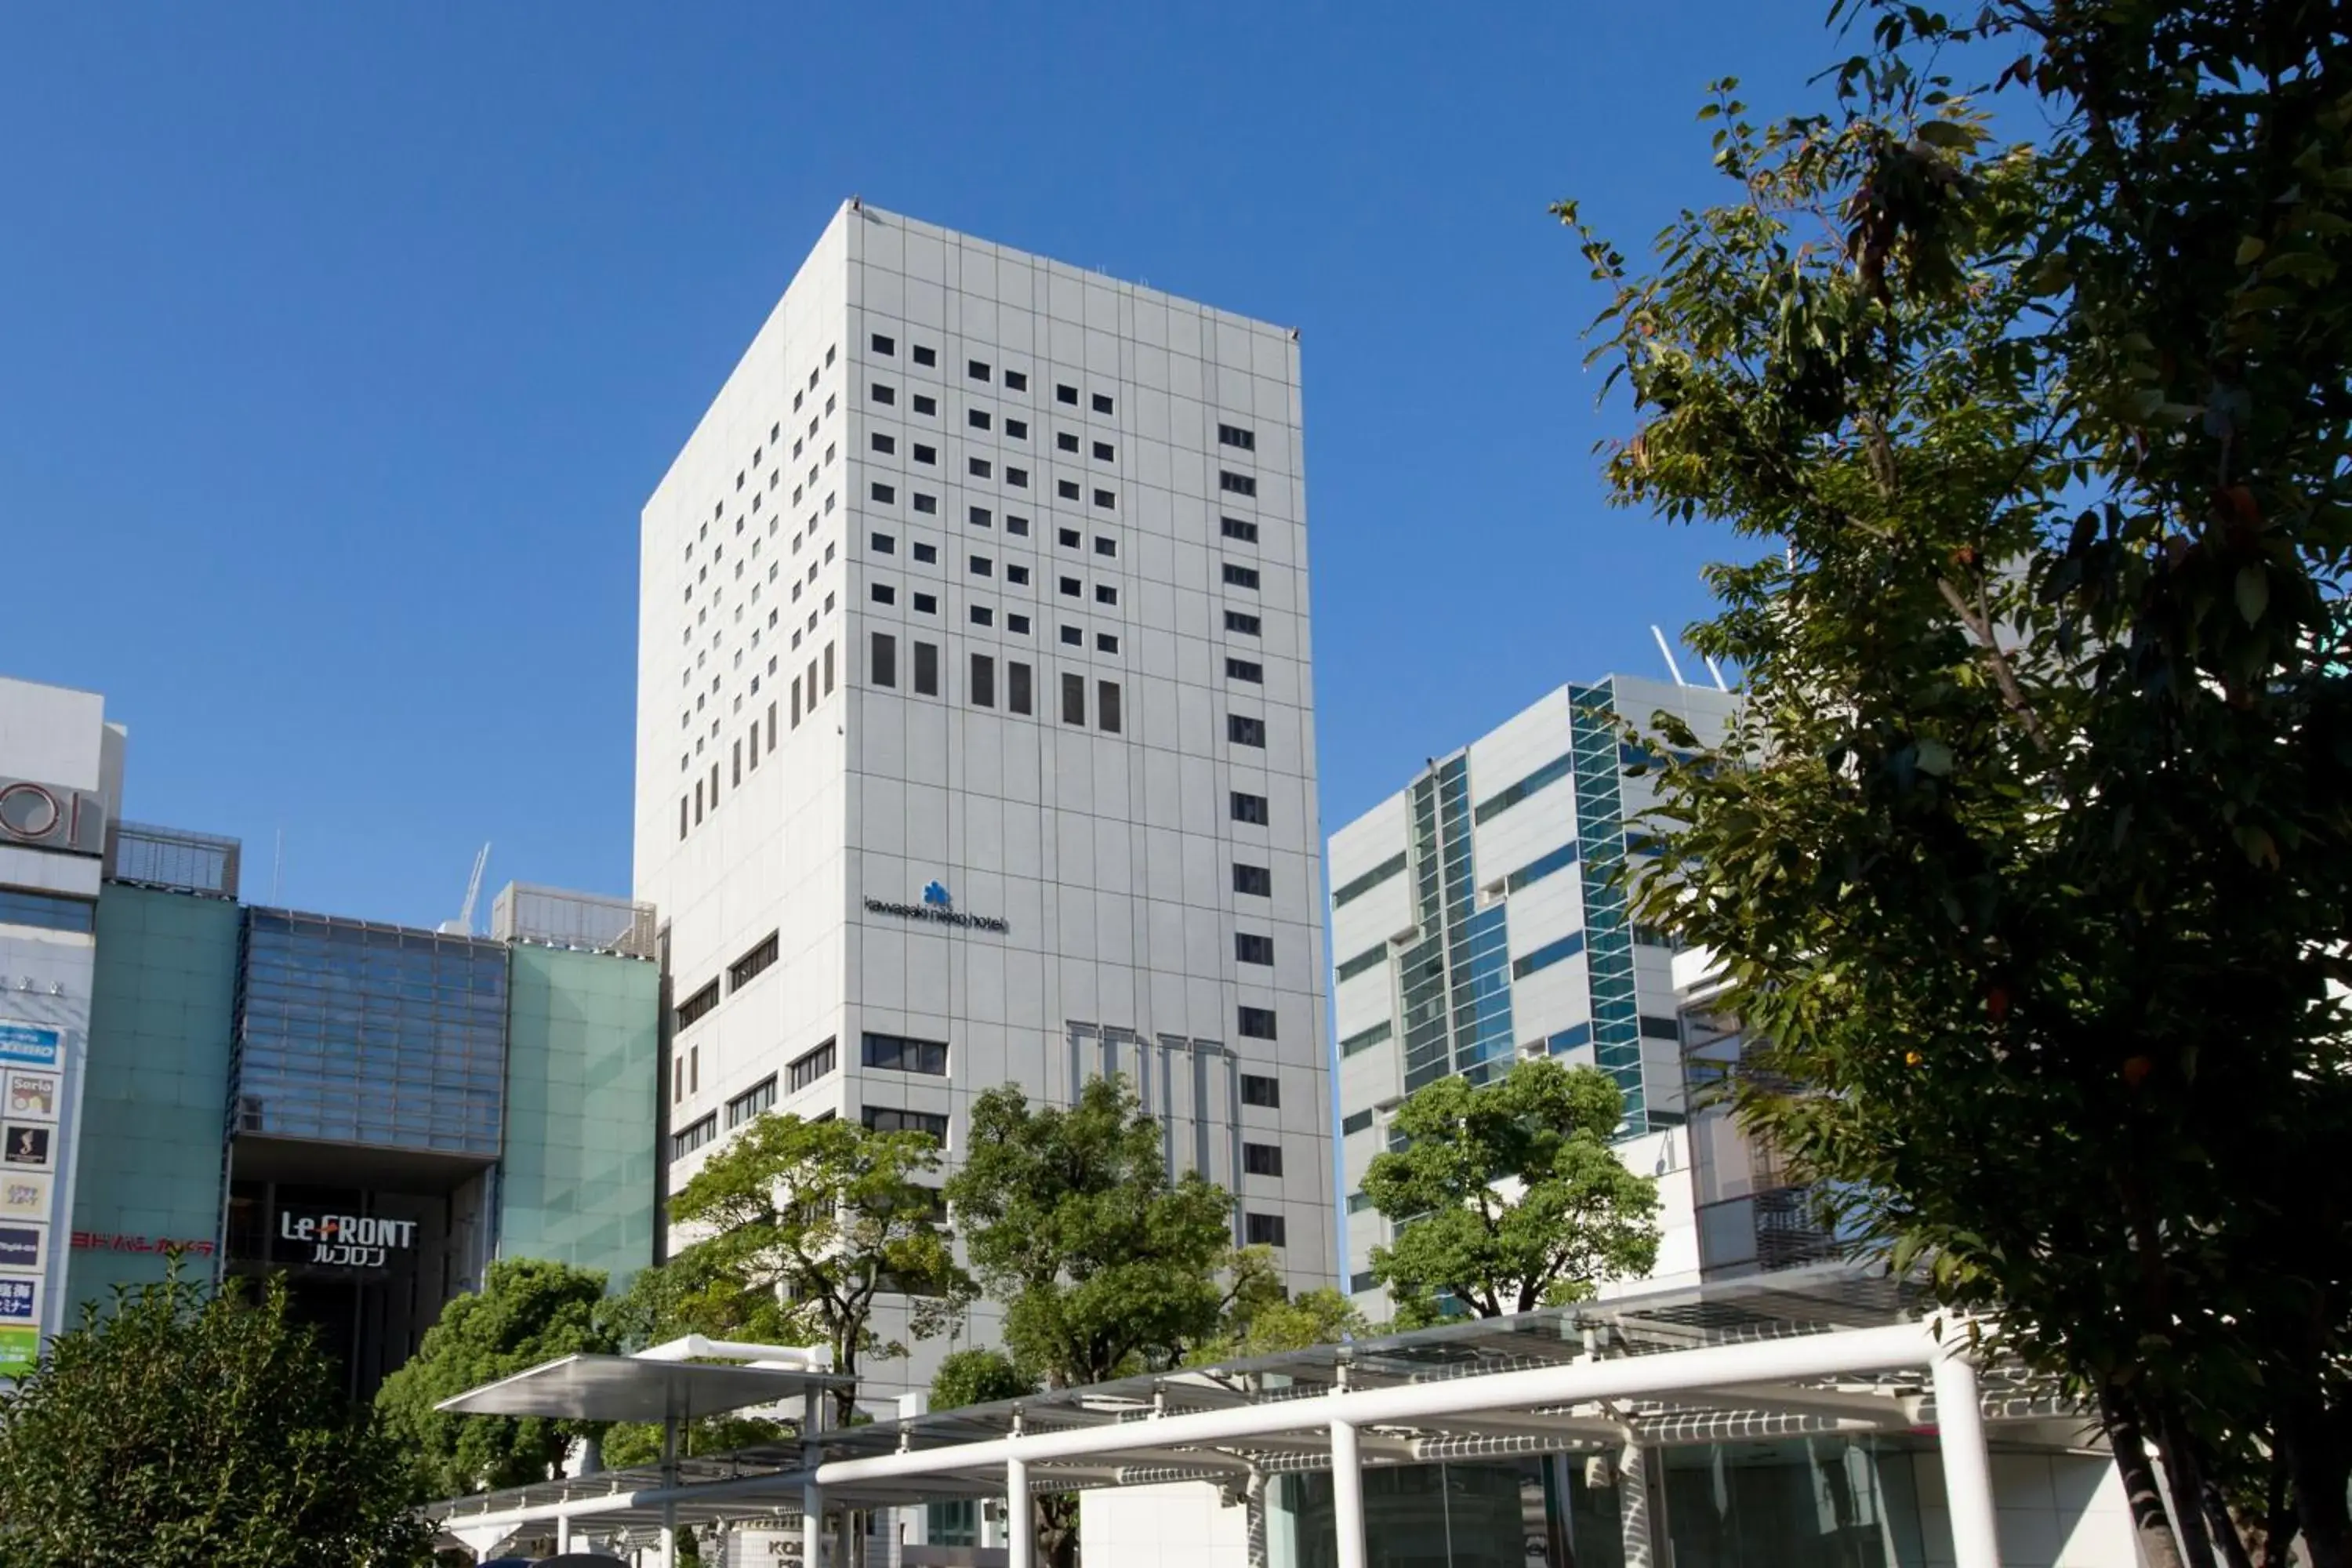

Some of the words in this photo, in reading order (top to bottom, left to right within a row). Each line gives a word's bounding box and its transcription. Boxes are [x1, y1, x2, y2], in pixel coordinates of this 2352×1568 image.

[864, 895, 927, 918] kawasaki
[929, 903, 967, 927] nikko
[969, 912, 1010, 935] hotel
[14, 1078, 51, 1091] Seria
[281, 1210, 314, 1240] Le
[320, 1214, 417, 1248] FRONT
[314, 1243, 385, 1266] ルフロン
